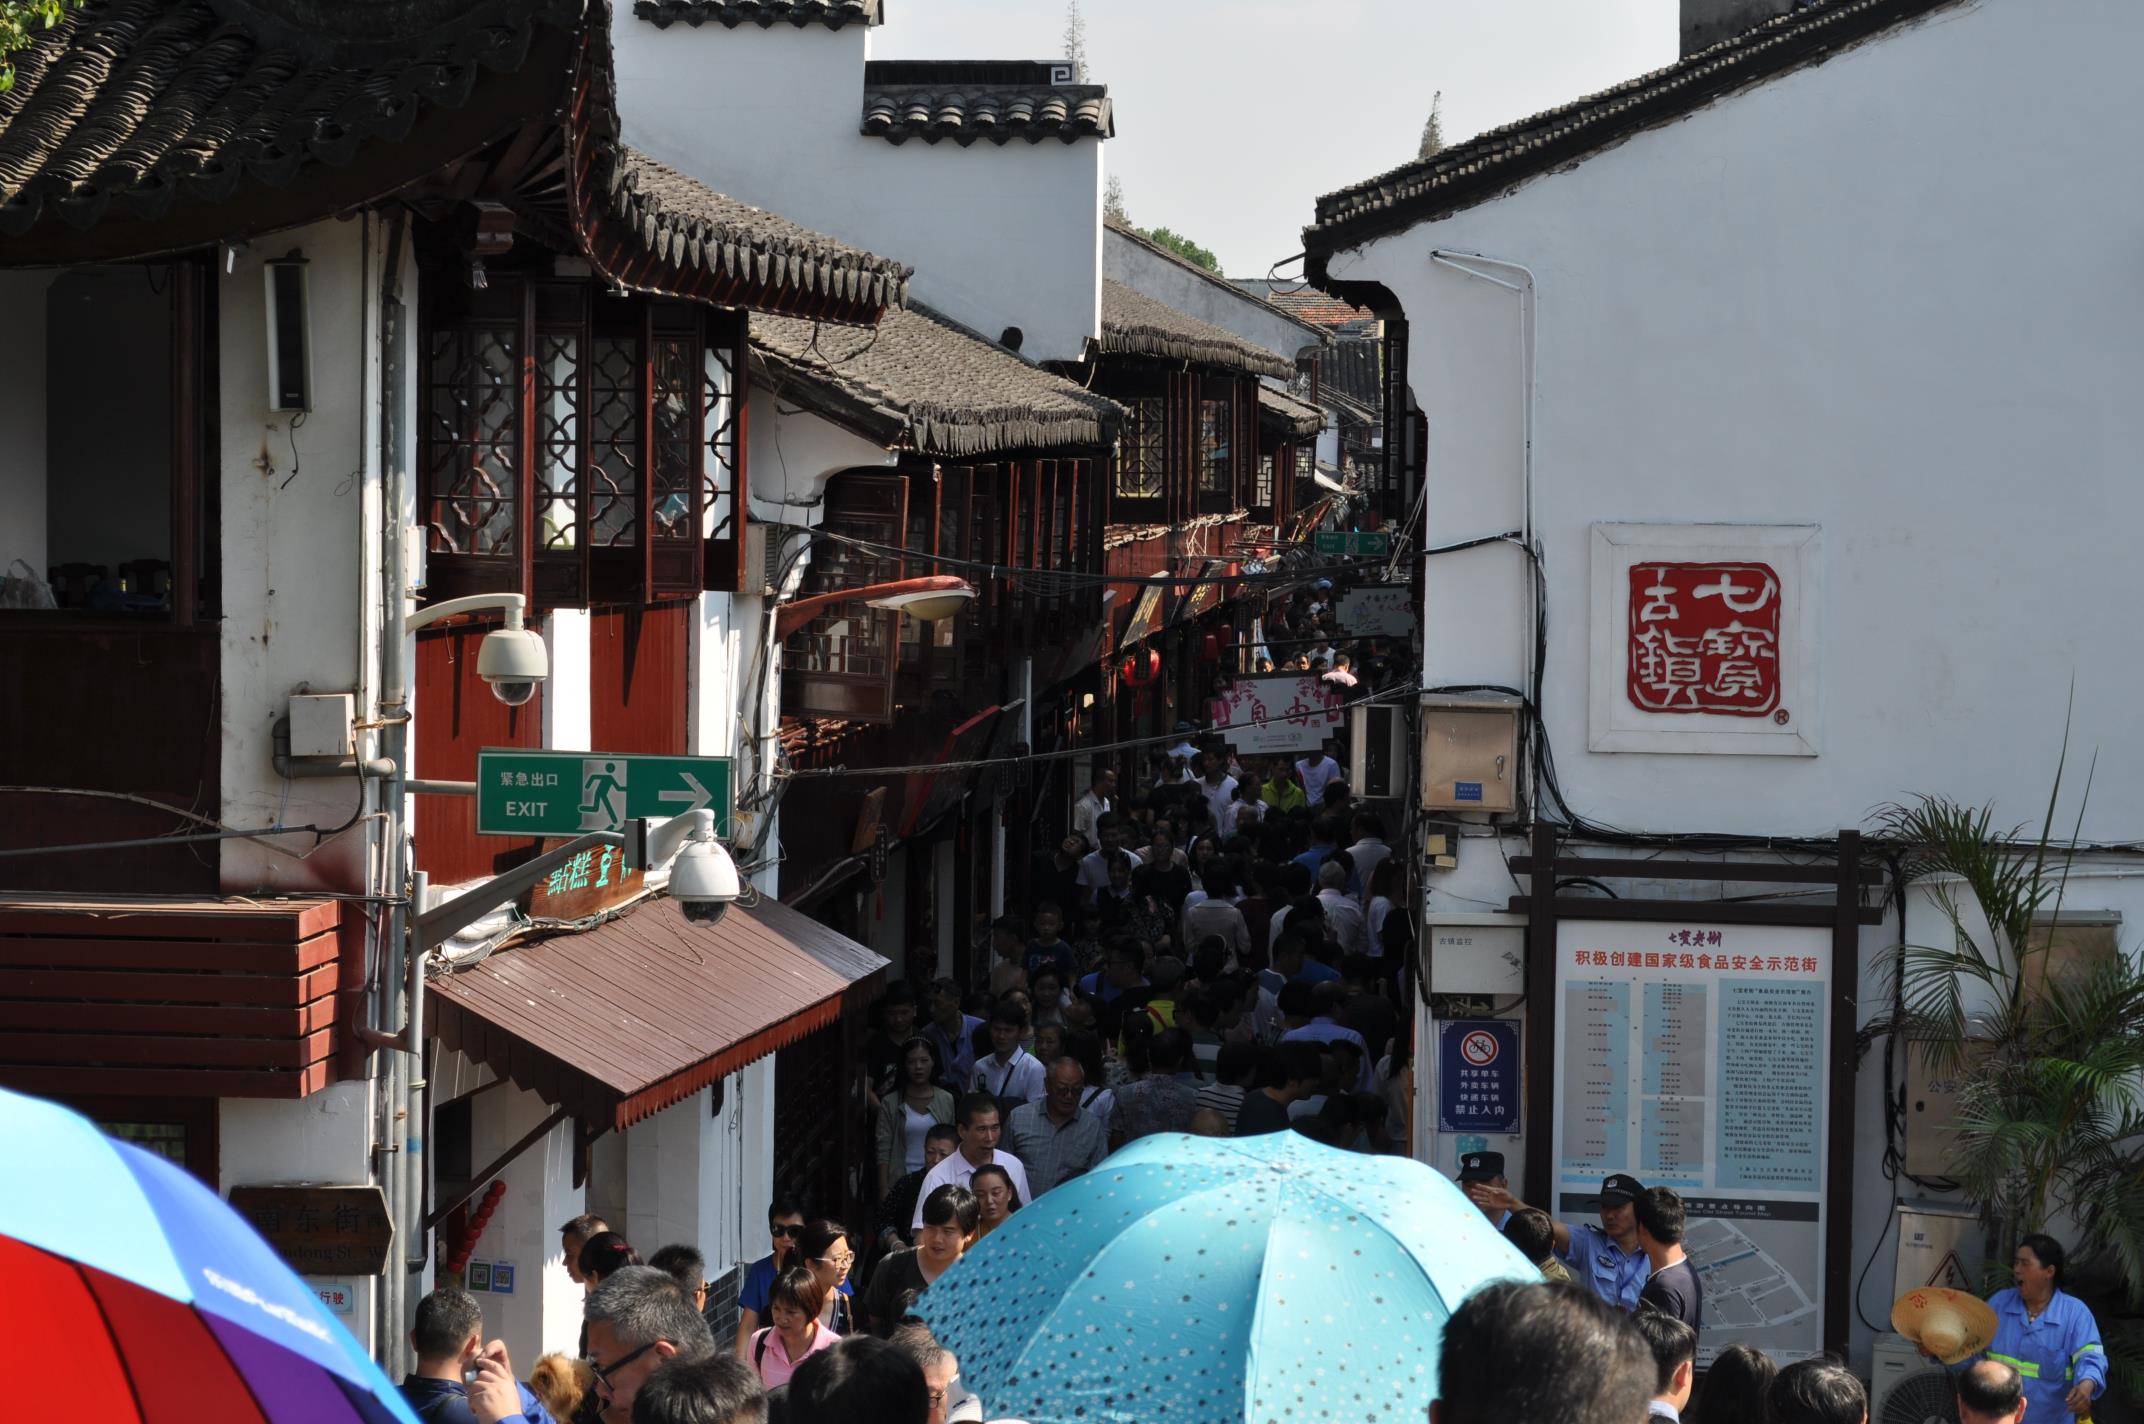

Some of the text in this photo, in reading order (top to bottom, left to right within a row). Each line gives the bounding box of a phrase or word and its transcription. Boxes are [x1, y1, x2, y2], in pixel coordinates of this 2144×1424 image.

[500, 771, 558, 787] 紧急出口
[506, 801, 548, 818] EXIT
[1439, 936, 1473, 946] 古镇监控
[1575, 950, 1817, 973] 积极创建国家级食品安全示范街
[1460, 1069, 1500, 1078] 共享单车
[1460, 1081, 1500, 1090] 外卖车辆
[1460, 1093, 1500, 1102] 快递车辆
[1455, 1104, 1505, 1116] 禁止入内
[254, 1204, 361, 1233] 南东街
[314, 1290, 344, 1305] 行驶
